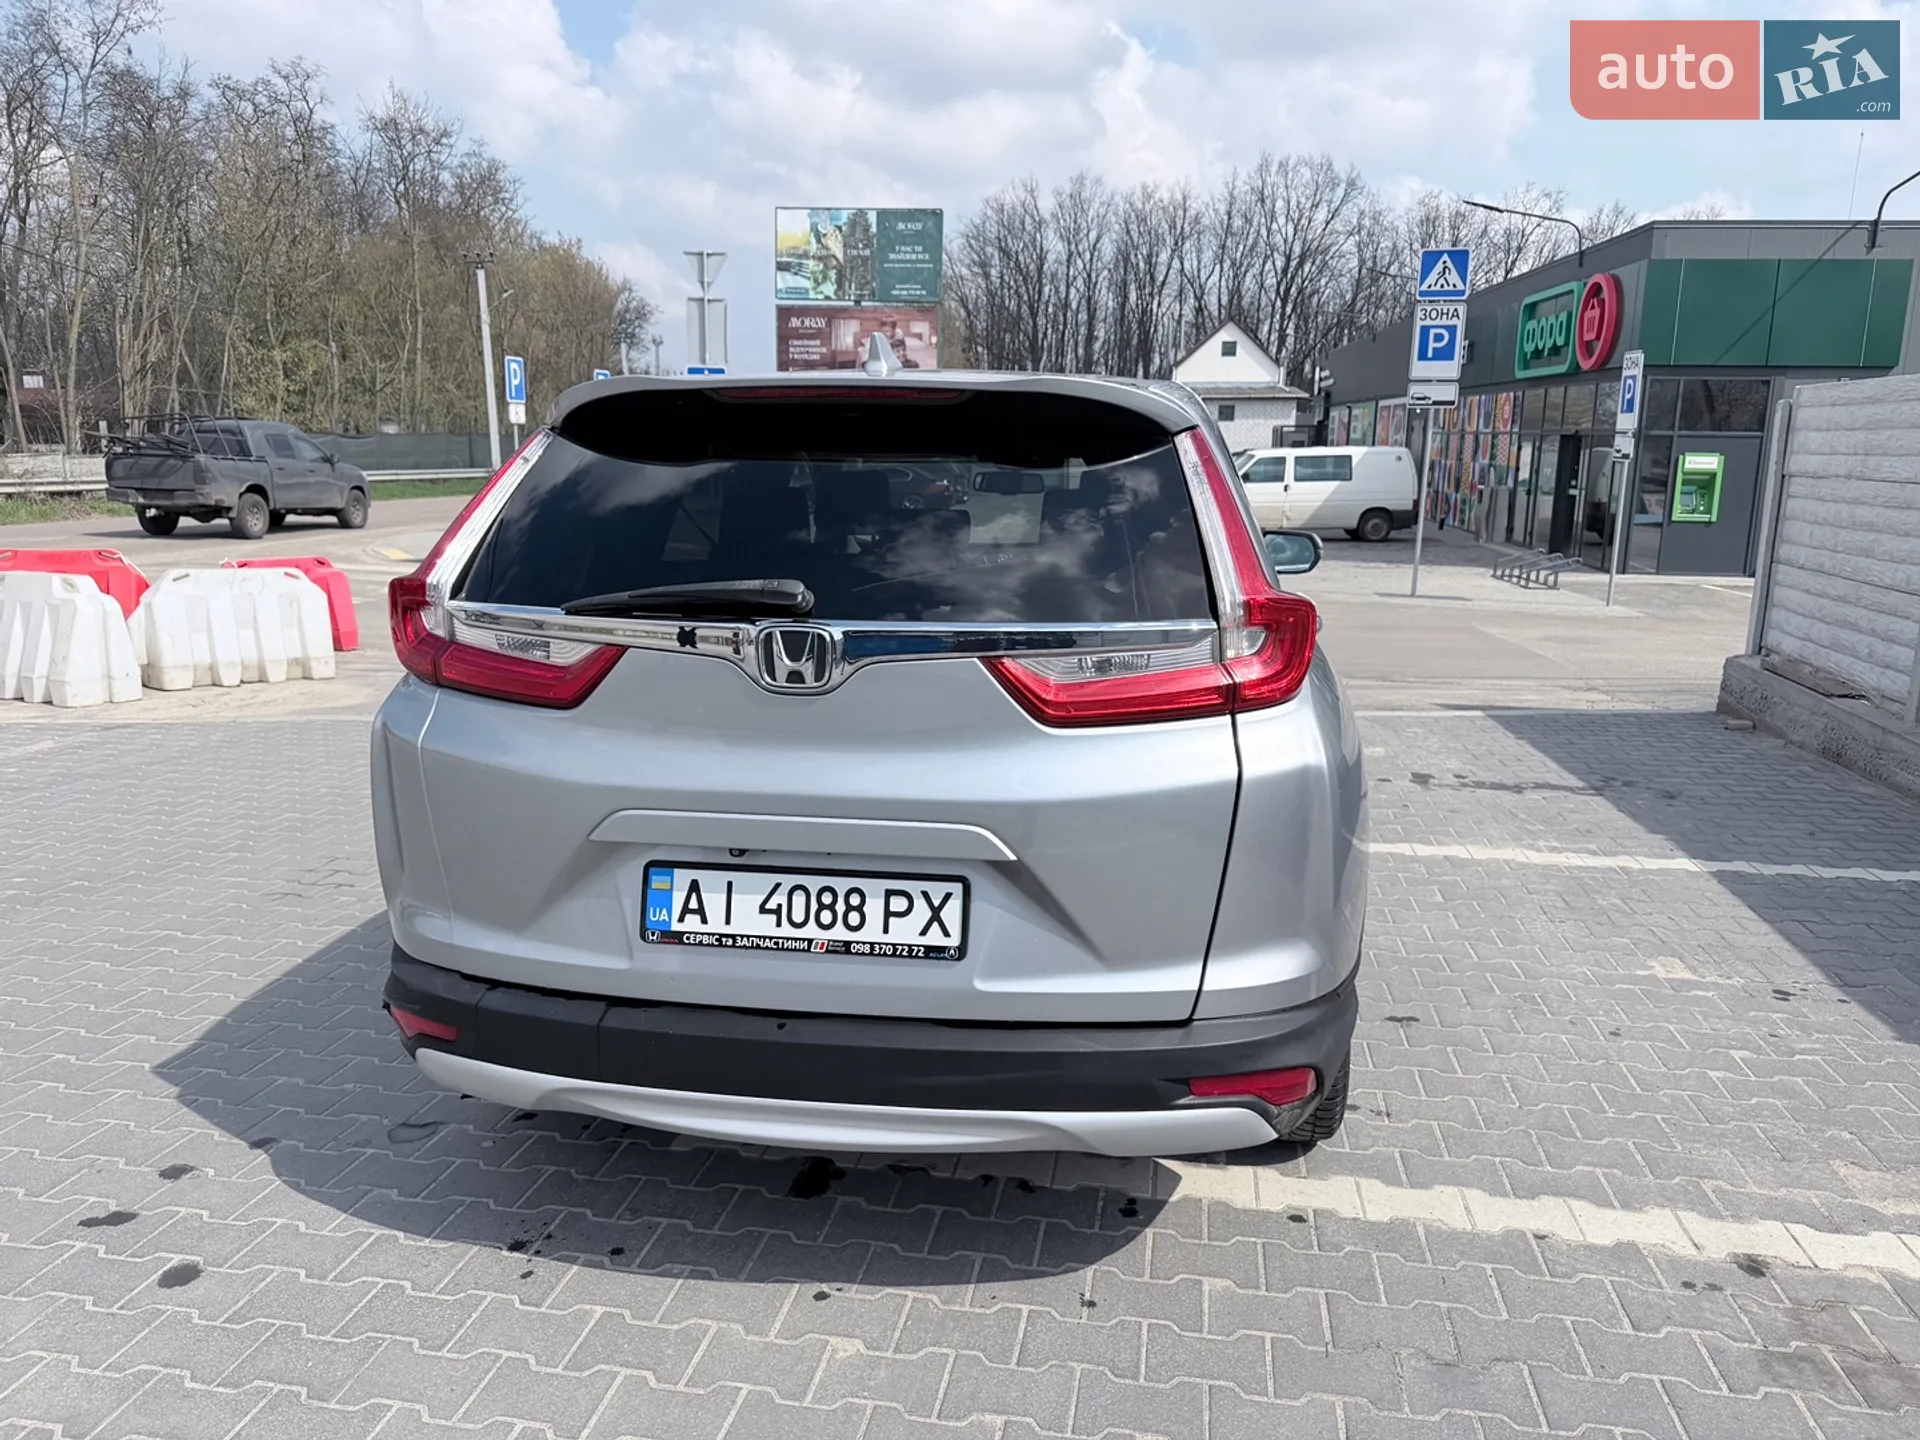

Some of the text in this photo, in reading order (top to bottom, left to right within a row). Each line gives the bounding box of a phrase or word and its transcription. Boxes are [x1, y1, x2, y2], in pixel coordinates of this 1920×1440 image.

[1419, 307, 1460, 321] ЗОНА
[788, 316, 828, 328] MORAY
[1523, 310, 1567, 360] фора
[1623, 356, 1639, 371] ЗОНА
[650, 907, 669, 921] UA
[677, 878, 954, 938] AI 4088 PX
[683, 933, 719, 945] СЕРВІС
[721, 937, 733, 945] та
[735, 936, 808, 950] ЗАПЧАСТИНИ
[850, 942, 925, 957] 098 370 72 72
